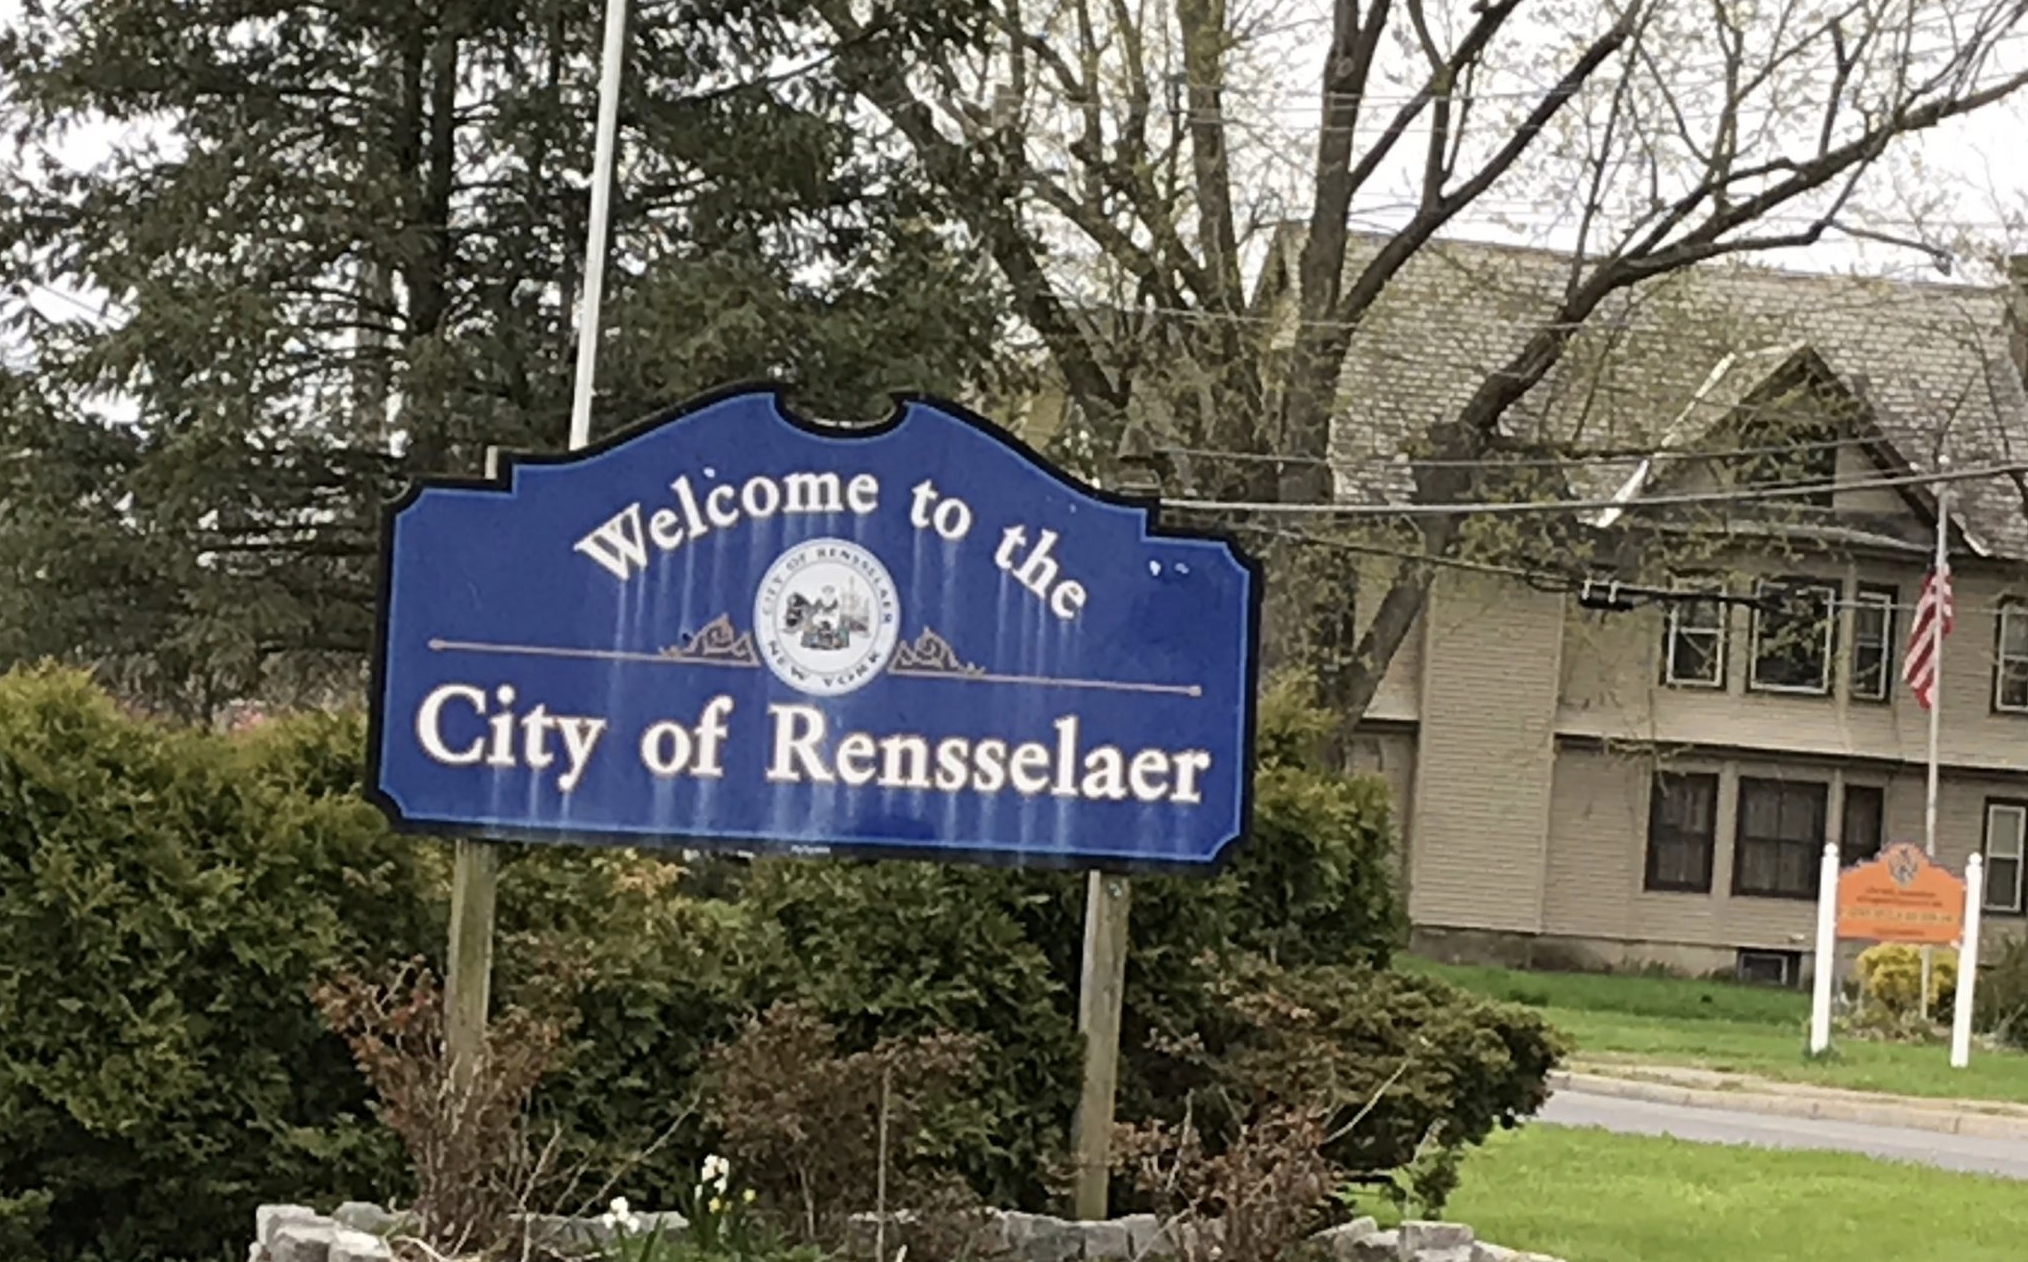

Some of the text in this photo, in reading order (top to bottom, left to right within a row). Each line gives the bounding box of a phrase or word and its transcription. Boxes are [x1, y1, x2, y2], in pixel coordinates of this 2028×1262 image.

[573, 470, 1086, 618] Welcome to the
[817, 548, 893, 624] RENSSELAER
[768, 640, 880, 687] NEW YORK
[415, 683, 1211, 804] City of Rensselaer
